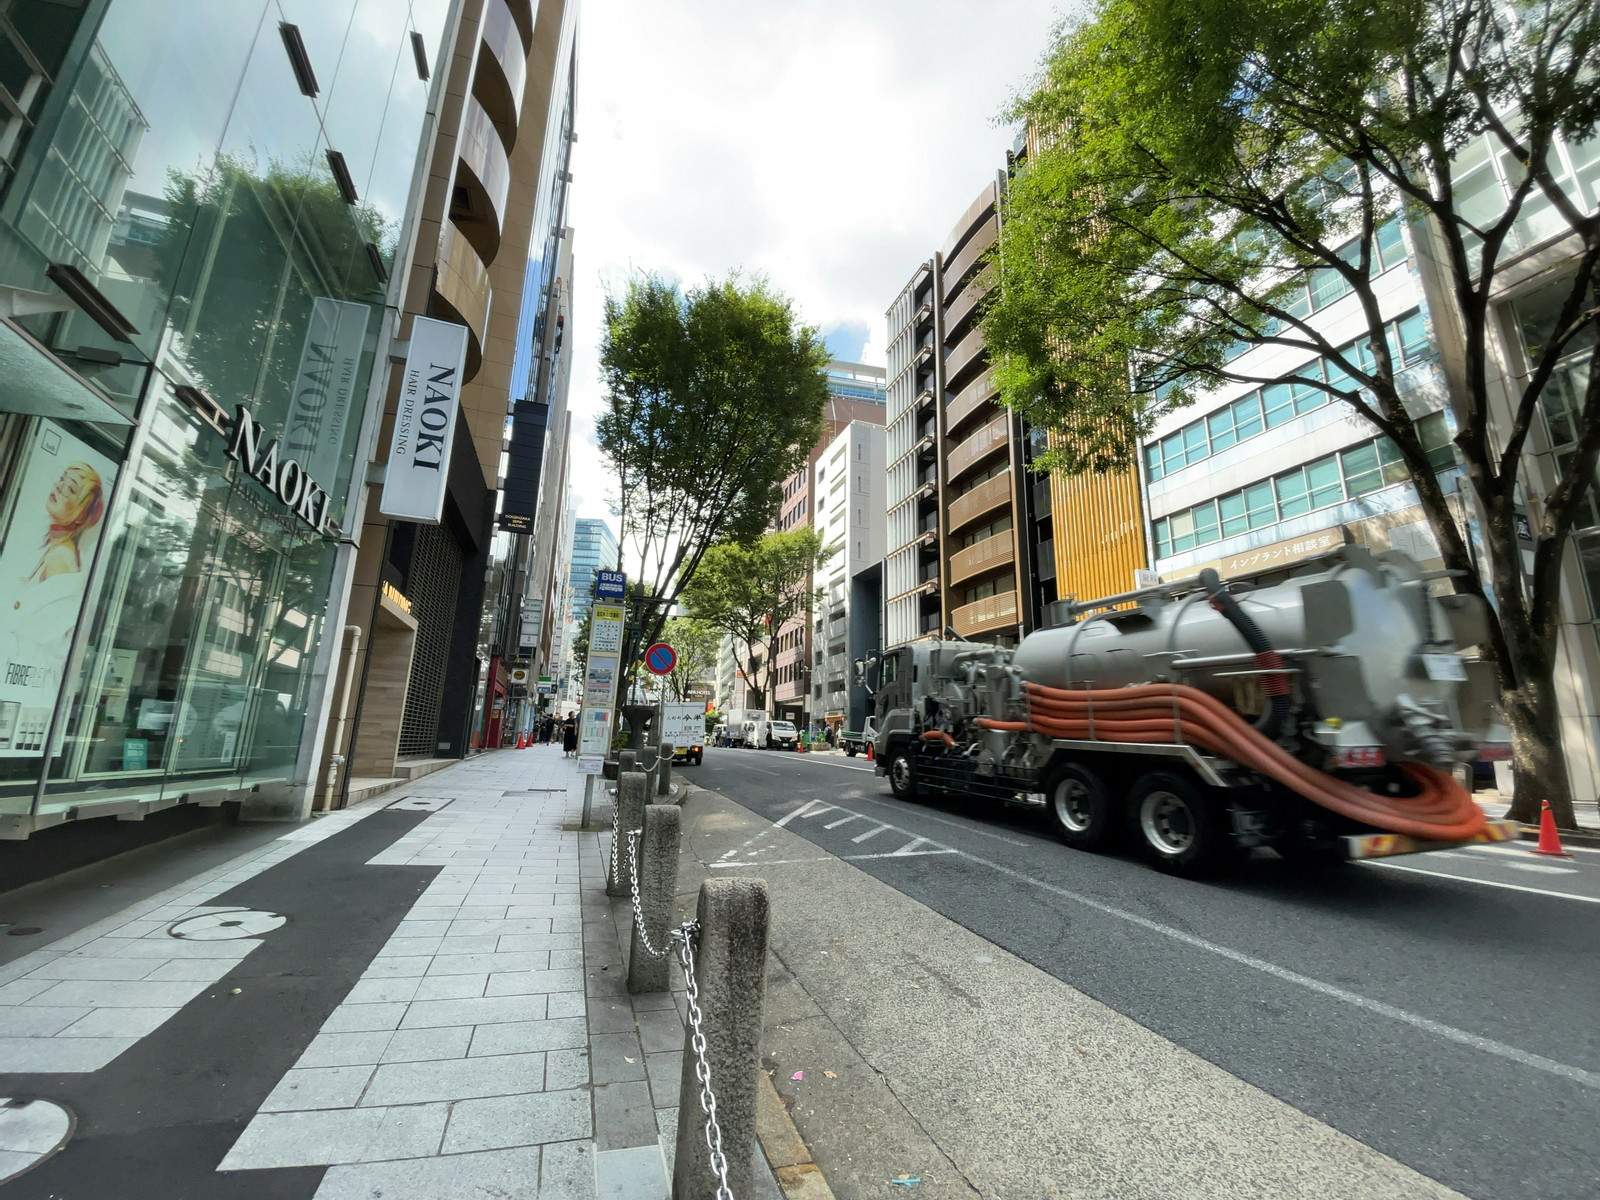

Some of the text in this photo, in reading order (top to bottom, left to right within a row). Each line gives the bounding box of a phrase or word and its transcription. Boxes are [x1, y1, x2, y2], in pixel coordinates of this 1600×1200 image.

[396, 369, 420, 455] HAIR DRESSING
[412, 363, 456, 472] NAOKI
[226, 404, 333, 535] NAOKI
[601, 572, 623, 582] BUS
[1230, 534, 1332, 571] インプラント相談室
